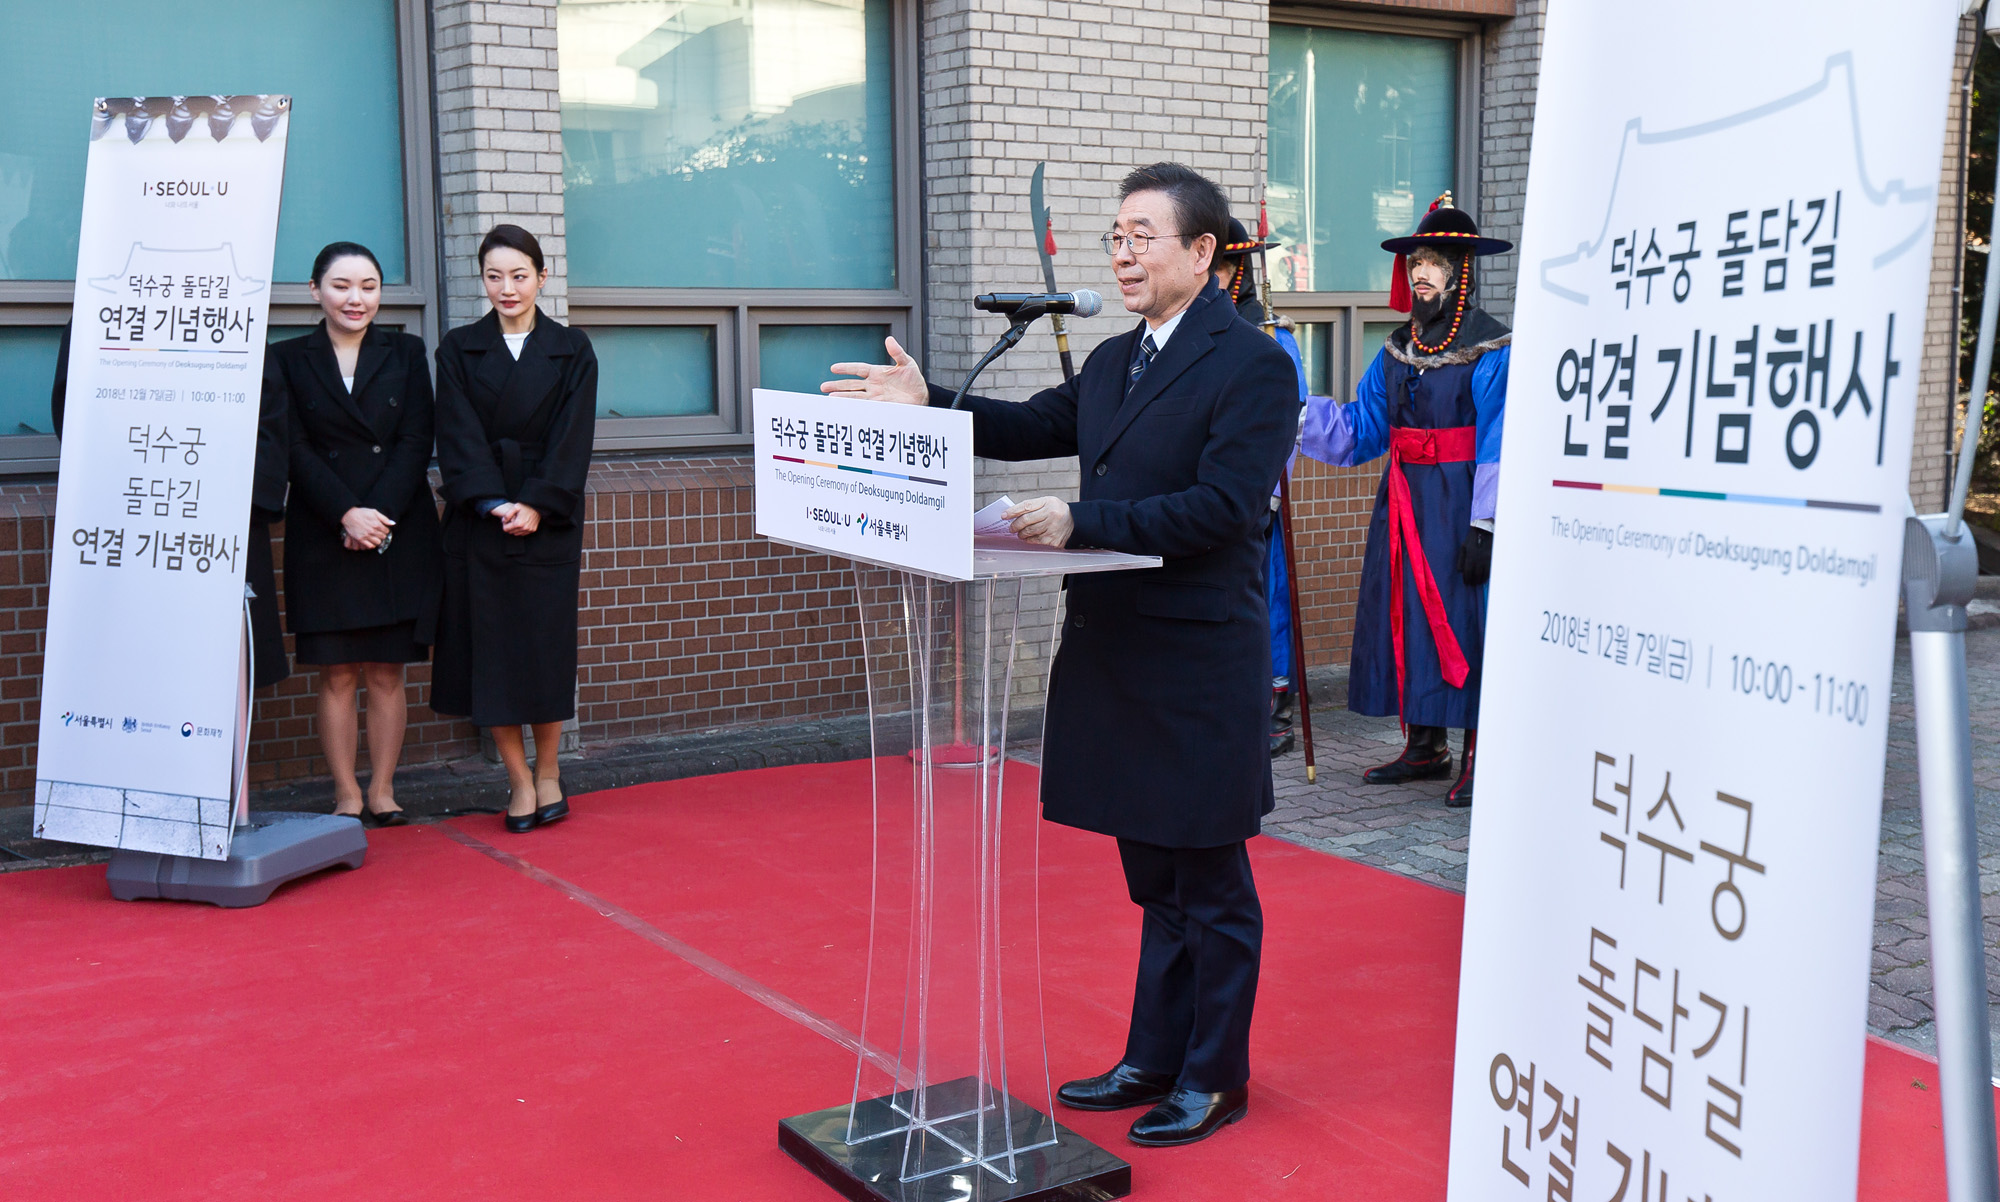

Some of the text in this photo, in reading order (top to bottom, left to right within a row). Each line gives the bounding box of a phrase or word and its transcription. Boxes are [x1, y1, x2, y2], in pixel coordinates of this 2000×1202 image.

[1610, 190, 1841, 309] 덕수궁 돌담길
[129, 274, 230, 299] 덕수궁 돌담길
[99, 304, 254, 344] 연결 기념행사
[96, 387, 126, 400] 2018년
[129, 388, 147, 401] 12월
[149, 389, 176, 402] 7일(금)
[191, 391, 216, 403] 10:00
[223, 392, 246, 404] 11:00
[1556, 312, 1900, 470] 연결 기념행사
[128, 424, 206, 465] 덕수궁
[771, 416, 948, 469] 덕수궁 돌담길 연결 기념행사
[123, 477, 201, 519] 돌담길
[774, 468, 945, 511] The Opening Ceremony of Deoksugung Doldamgil
[72, 527, 240, 574] 연결 기념행사
[868, 519, 908, 542] 서울특별시
[1551, 516, 1877, 587] The Opening Ceremony of Deoksugung Doldamgil
[1541, 610, 1590, 655] 2018년
[1597, 623, 1629, 666] 12월
[1636, 631, 1693, 684] 7일(금)
[1731, 654, 1793, 704] 10:00
[1814, 673, 1869, 726] 11:00
[74, 714, 113, 730] 서울특별시
[1592, 751, 1766, 941] 덕수궁
[1577, 926, 1750, 1159] 돌담길
